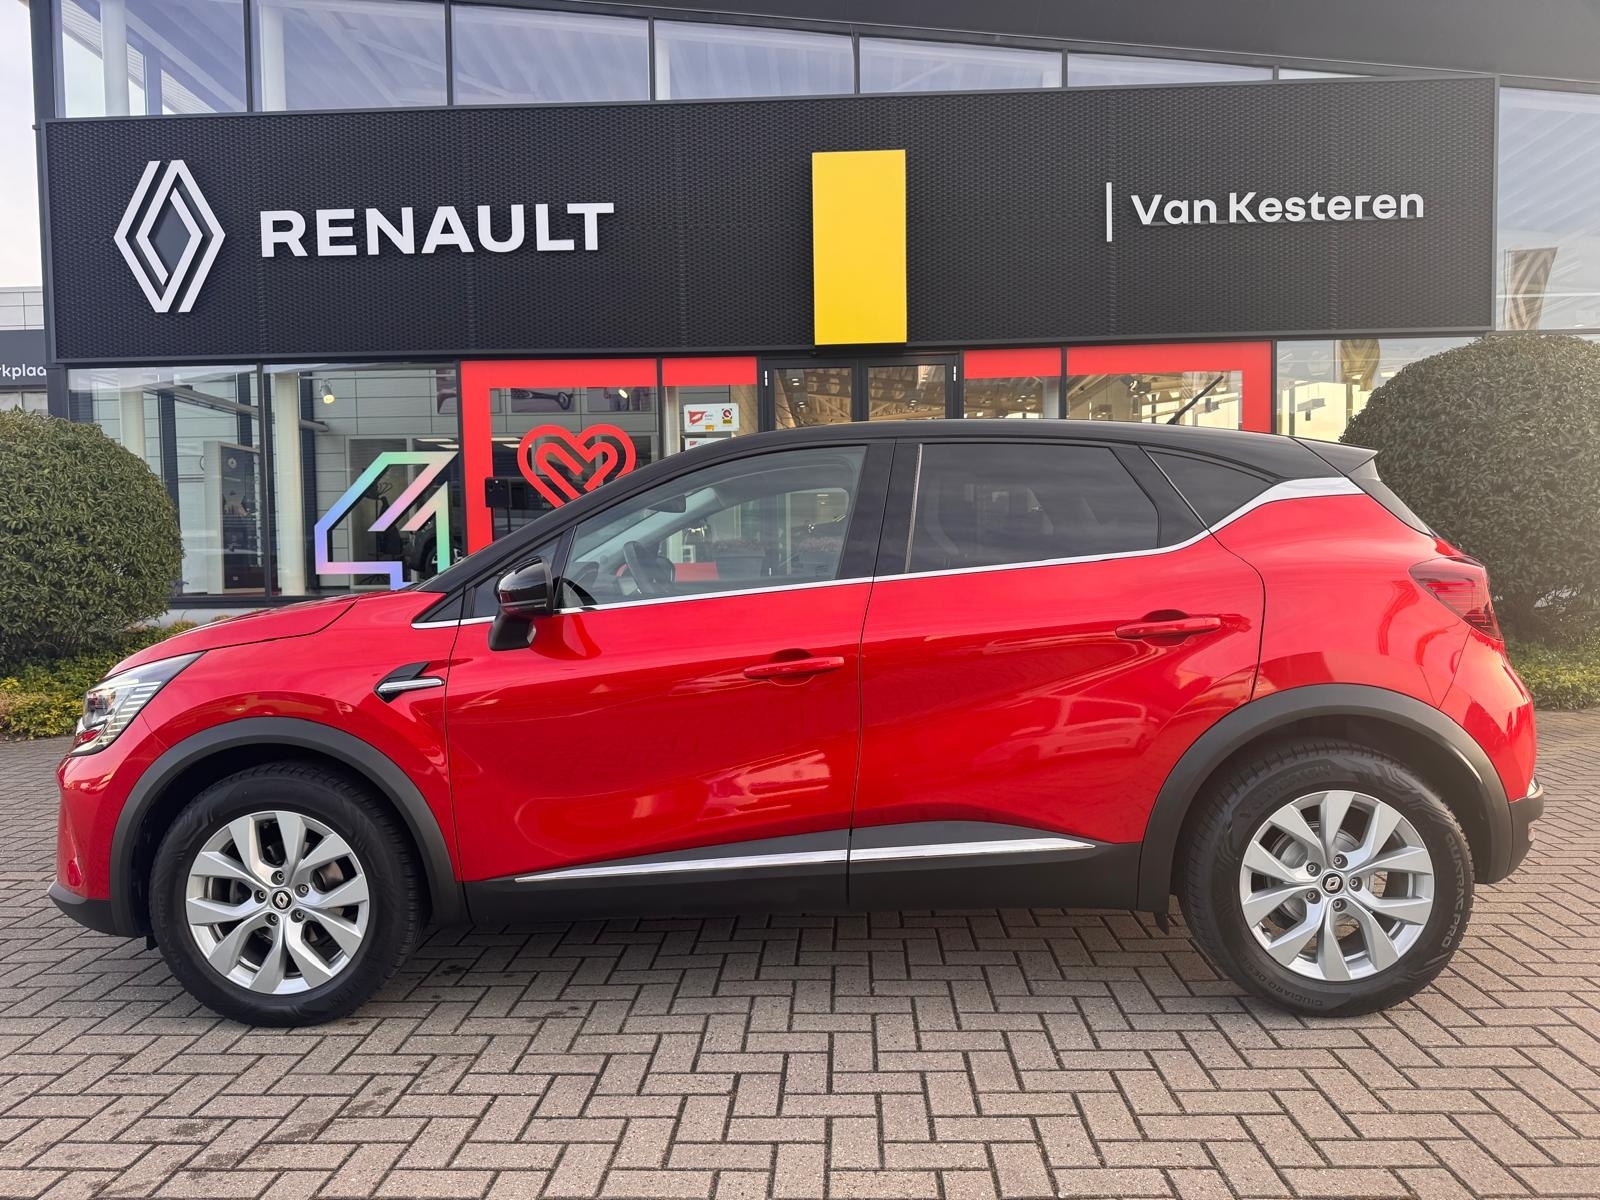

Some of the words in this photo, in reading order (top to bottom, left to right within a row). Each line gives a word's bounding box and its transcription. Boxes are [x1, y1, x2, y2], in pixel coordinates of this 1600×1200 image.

[260, 202, 615, 258] RENAULT
[1131, 194, 1217, 226] Van
[1228, 191, 1424, 224] Kesteren
